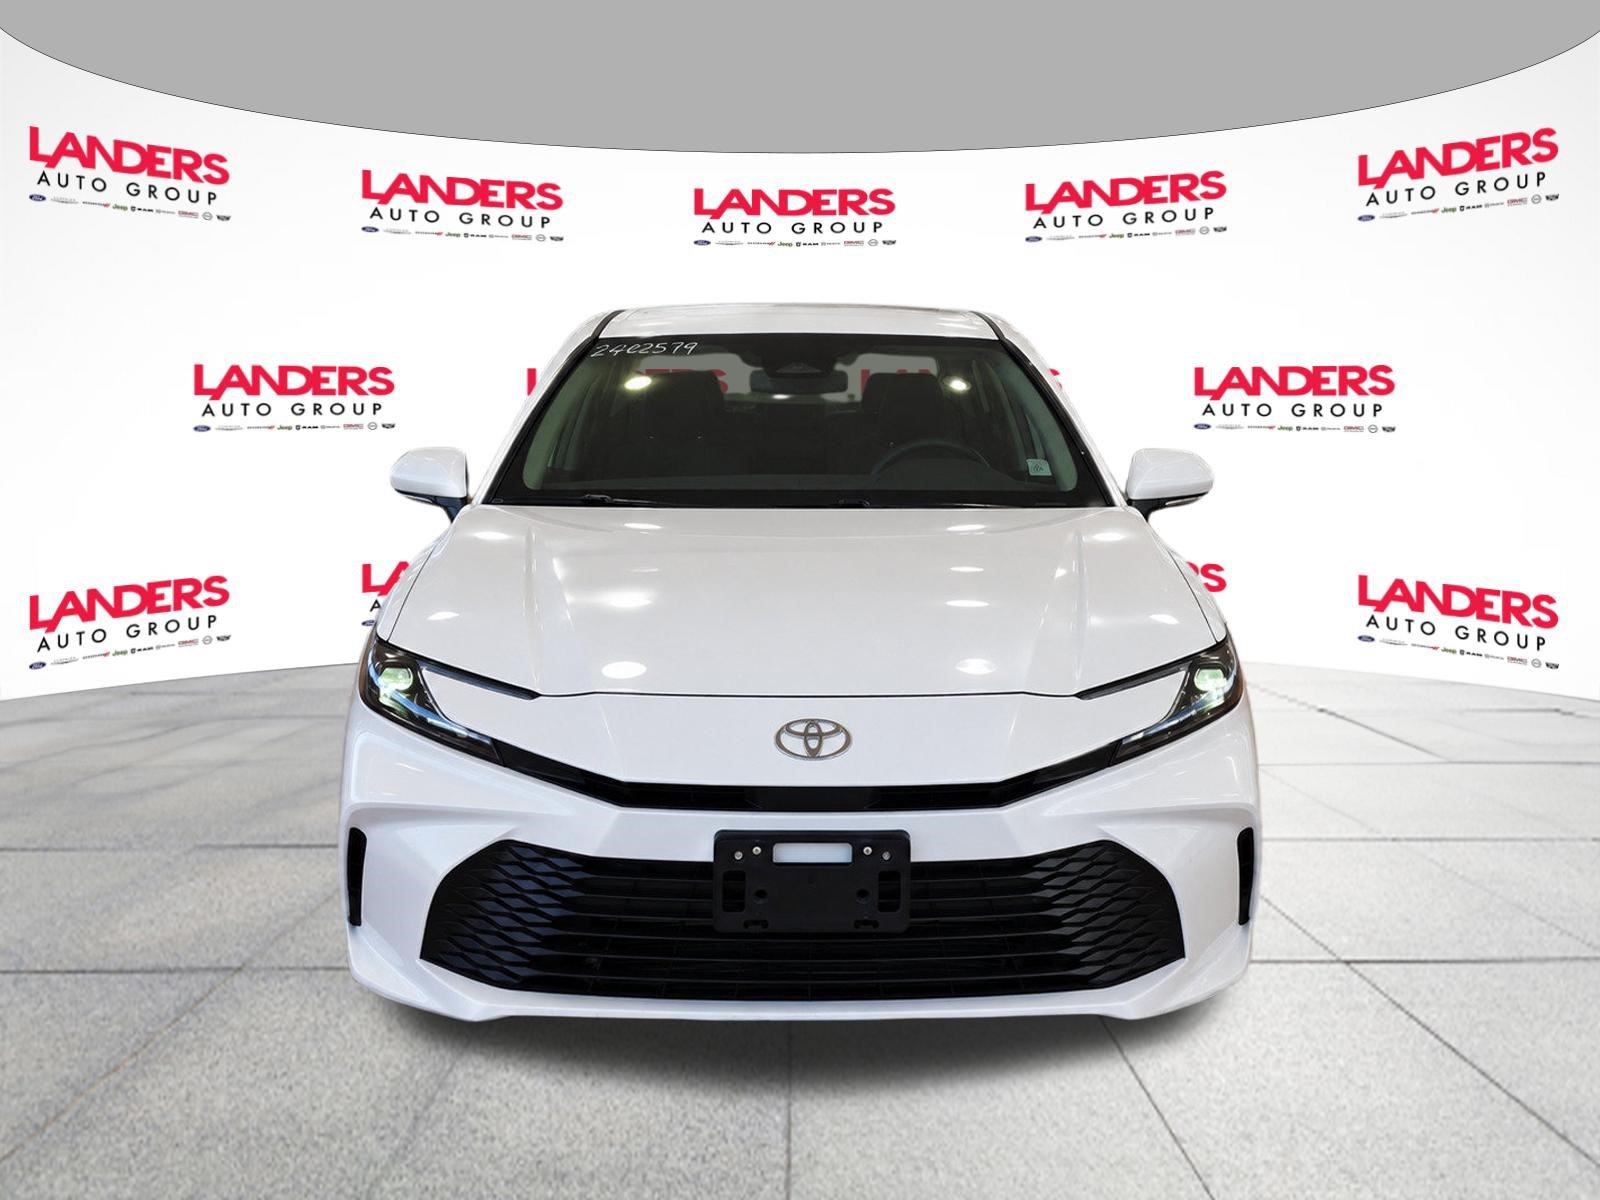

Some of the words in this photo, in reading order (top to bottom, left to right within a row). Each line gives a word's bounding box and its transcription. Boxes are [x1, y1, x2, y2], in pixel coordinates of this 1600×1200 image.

[29, 126, 230, 185] LANDERS
[1357, 127, 1559, 190] LANDERS
[36, 170, 107, 193] AUTO
[126, 182, 217, 206] GROUP
[361, 169, 564, 211] LANDERS
[693, 187, 896, 220] LANDERS
[1024, 170, 1227, 215] LANDERS
[1365, 185, 1436, 207] AUTO
[1454, 171, 1546, 196] GROUP
[369, 206, 440, 224] AUTO
[458, 212, 551, 229] GROUP
[701, 221, 772, 235] AUTO
[791, 221, 883, 235] GROUP
[1032, 214, 1104, 229] AUTO
[1122, 207, 1214, 225] GROUP
[193, 363, 395, 401] LANDERS
[1193, 364, 1396, 401] LANDERS
[201, 402, 272, 417] AUTO
[290, 402, 382, 416] GROUP
[1201, 403, 1272, 417] AUTO
[1291, 402, 1383, 418] GROUP
[29, 575, 230, 634] LANDERS
[1357, 574, 1559, 630] LANDERS
[36, 628, 107, 653] AUTO
[125, 614, 217, 639] GROUP
[1365, 614, 1436, 636] AUTO
[1454, 625, 1546, 652] GROUP
